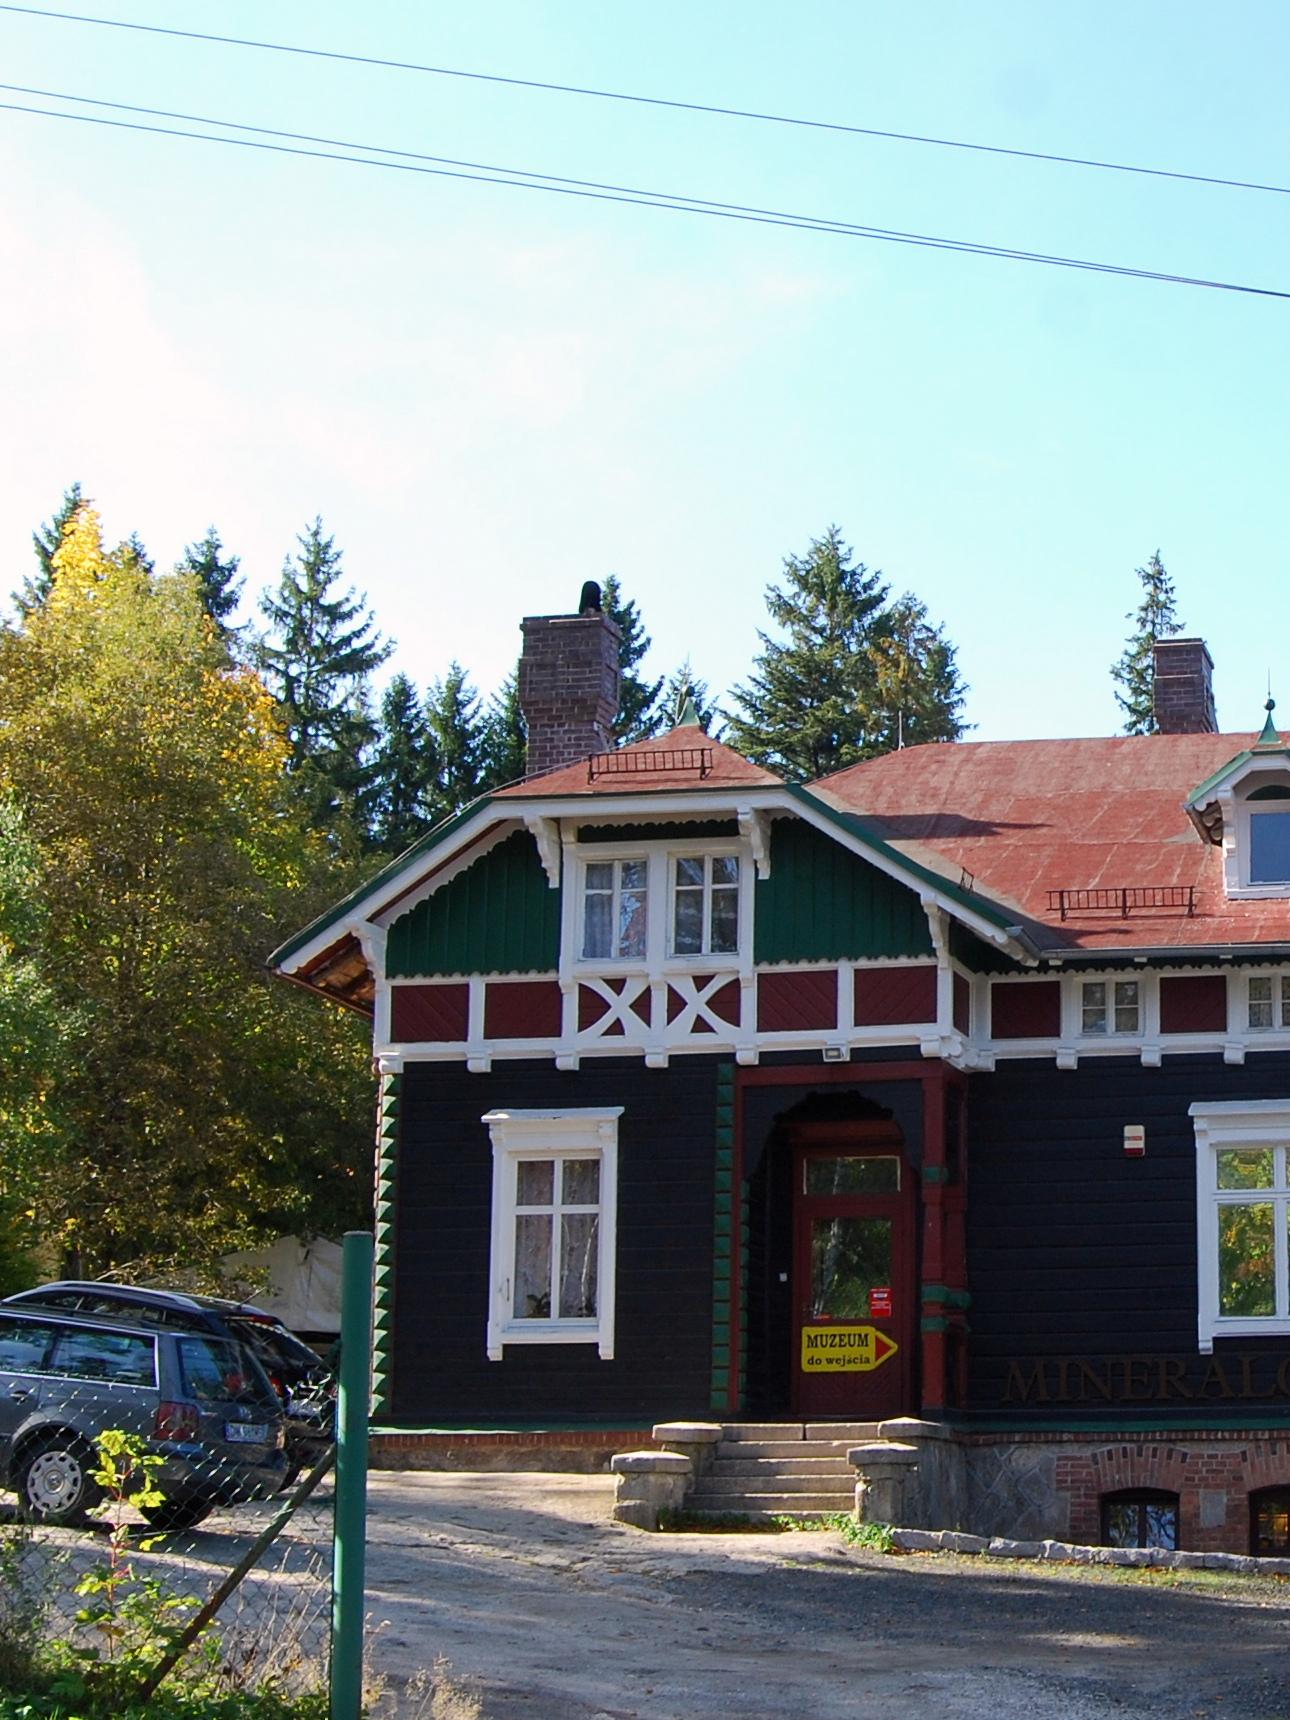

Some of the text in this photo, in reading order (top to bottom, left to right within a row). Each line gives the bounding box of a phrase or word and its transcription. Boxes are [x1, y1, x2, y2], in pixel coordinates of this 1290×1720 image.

[806, 1333, 869, 1348] MUZEUM
[807, 1355, 870, 1367] do wejścia
